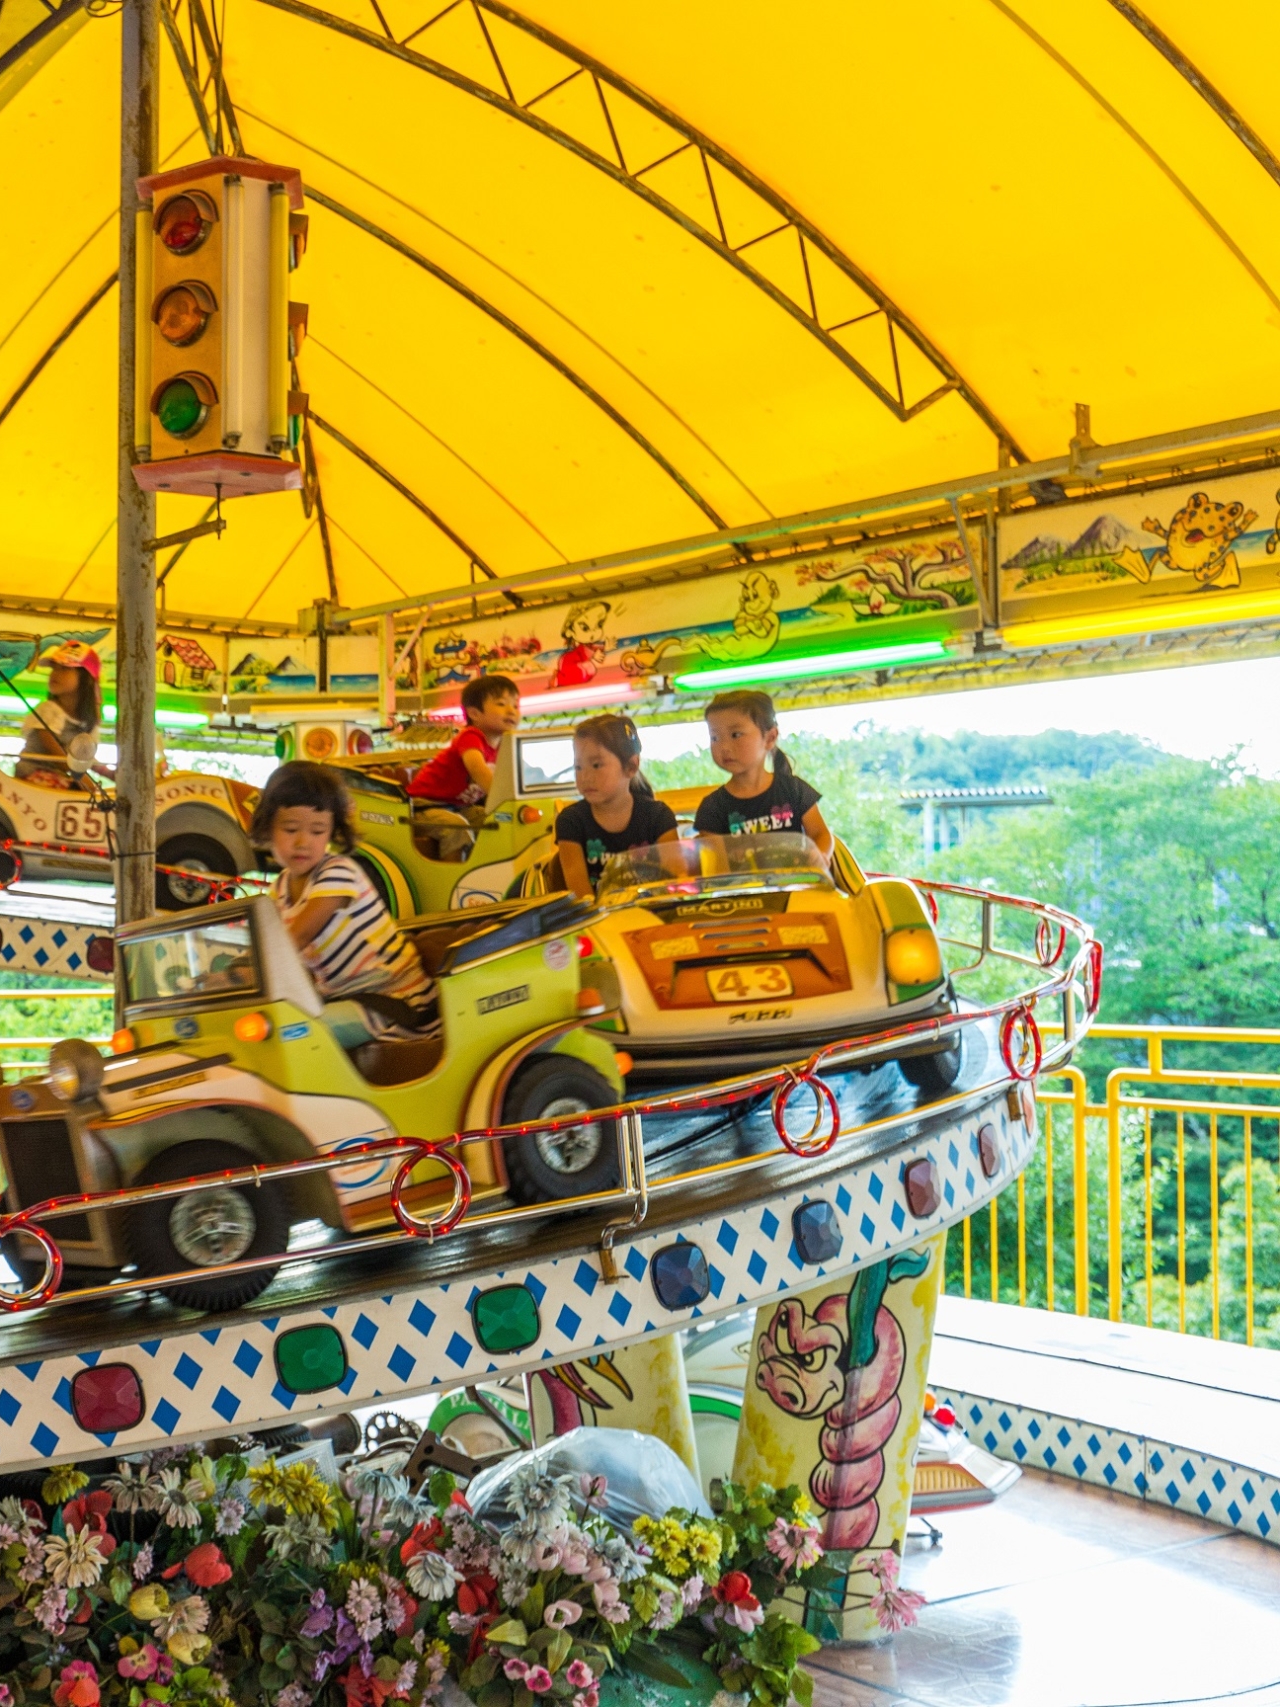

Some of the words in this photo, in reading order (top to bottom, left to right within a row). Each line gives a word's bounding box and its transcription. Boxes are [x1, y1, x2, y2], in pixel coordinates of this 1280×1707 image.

[59, 805, 102, 839] 65
[729, 812, 794, 838] SWEET
[681, 899, 762, 916] MARTINI
[716, 966, 787, 998] 43
